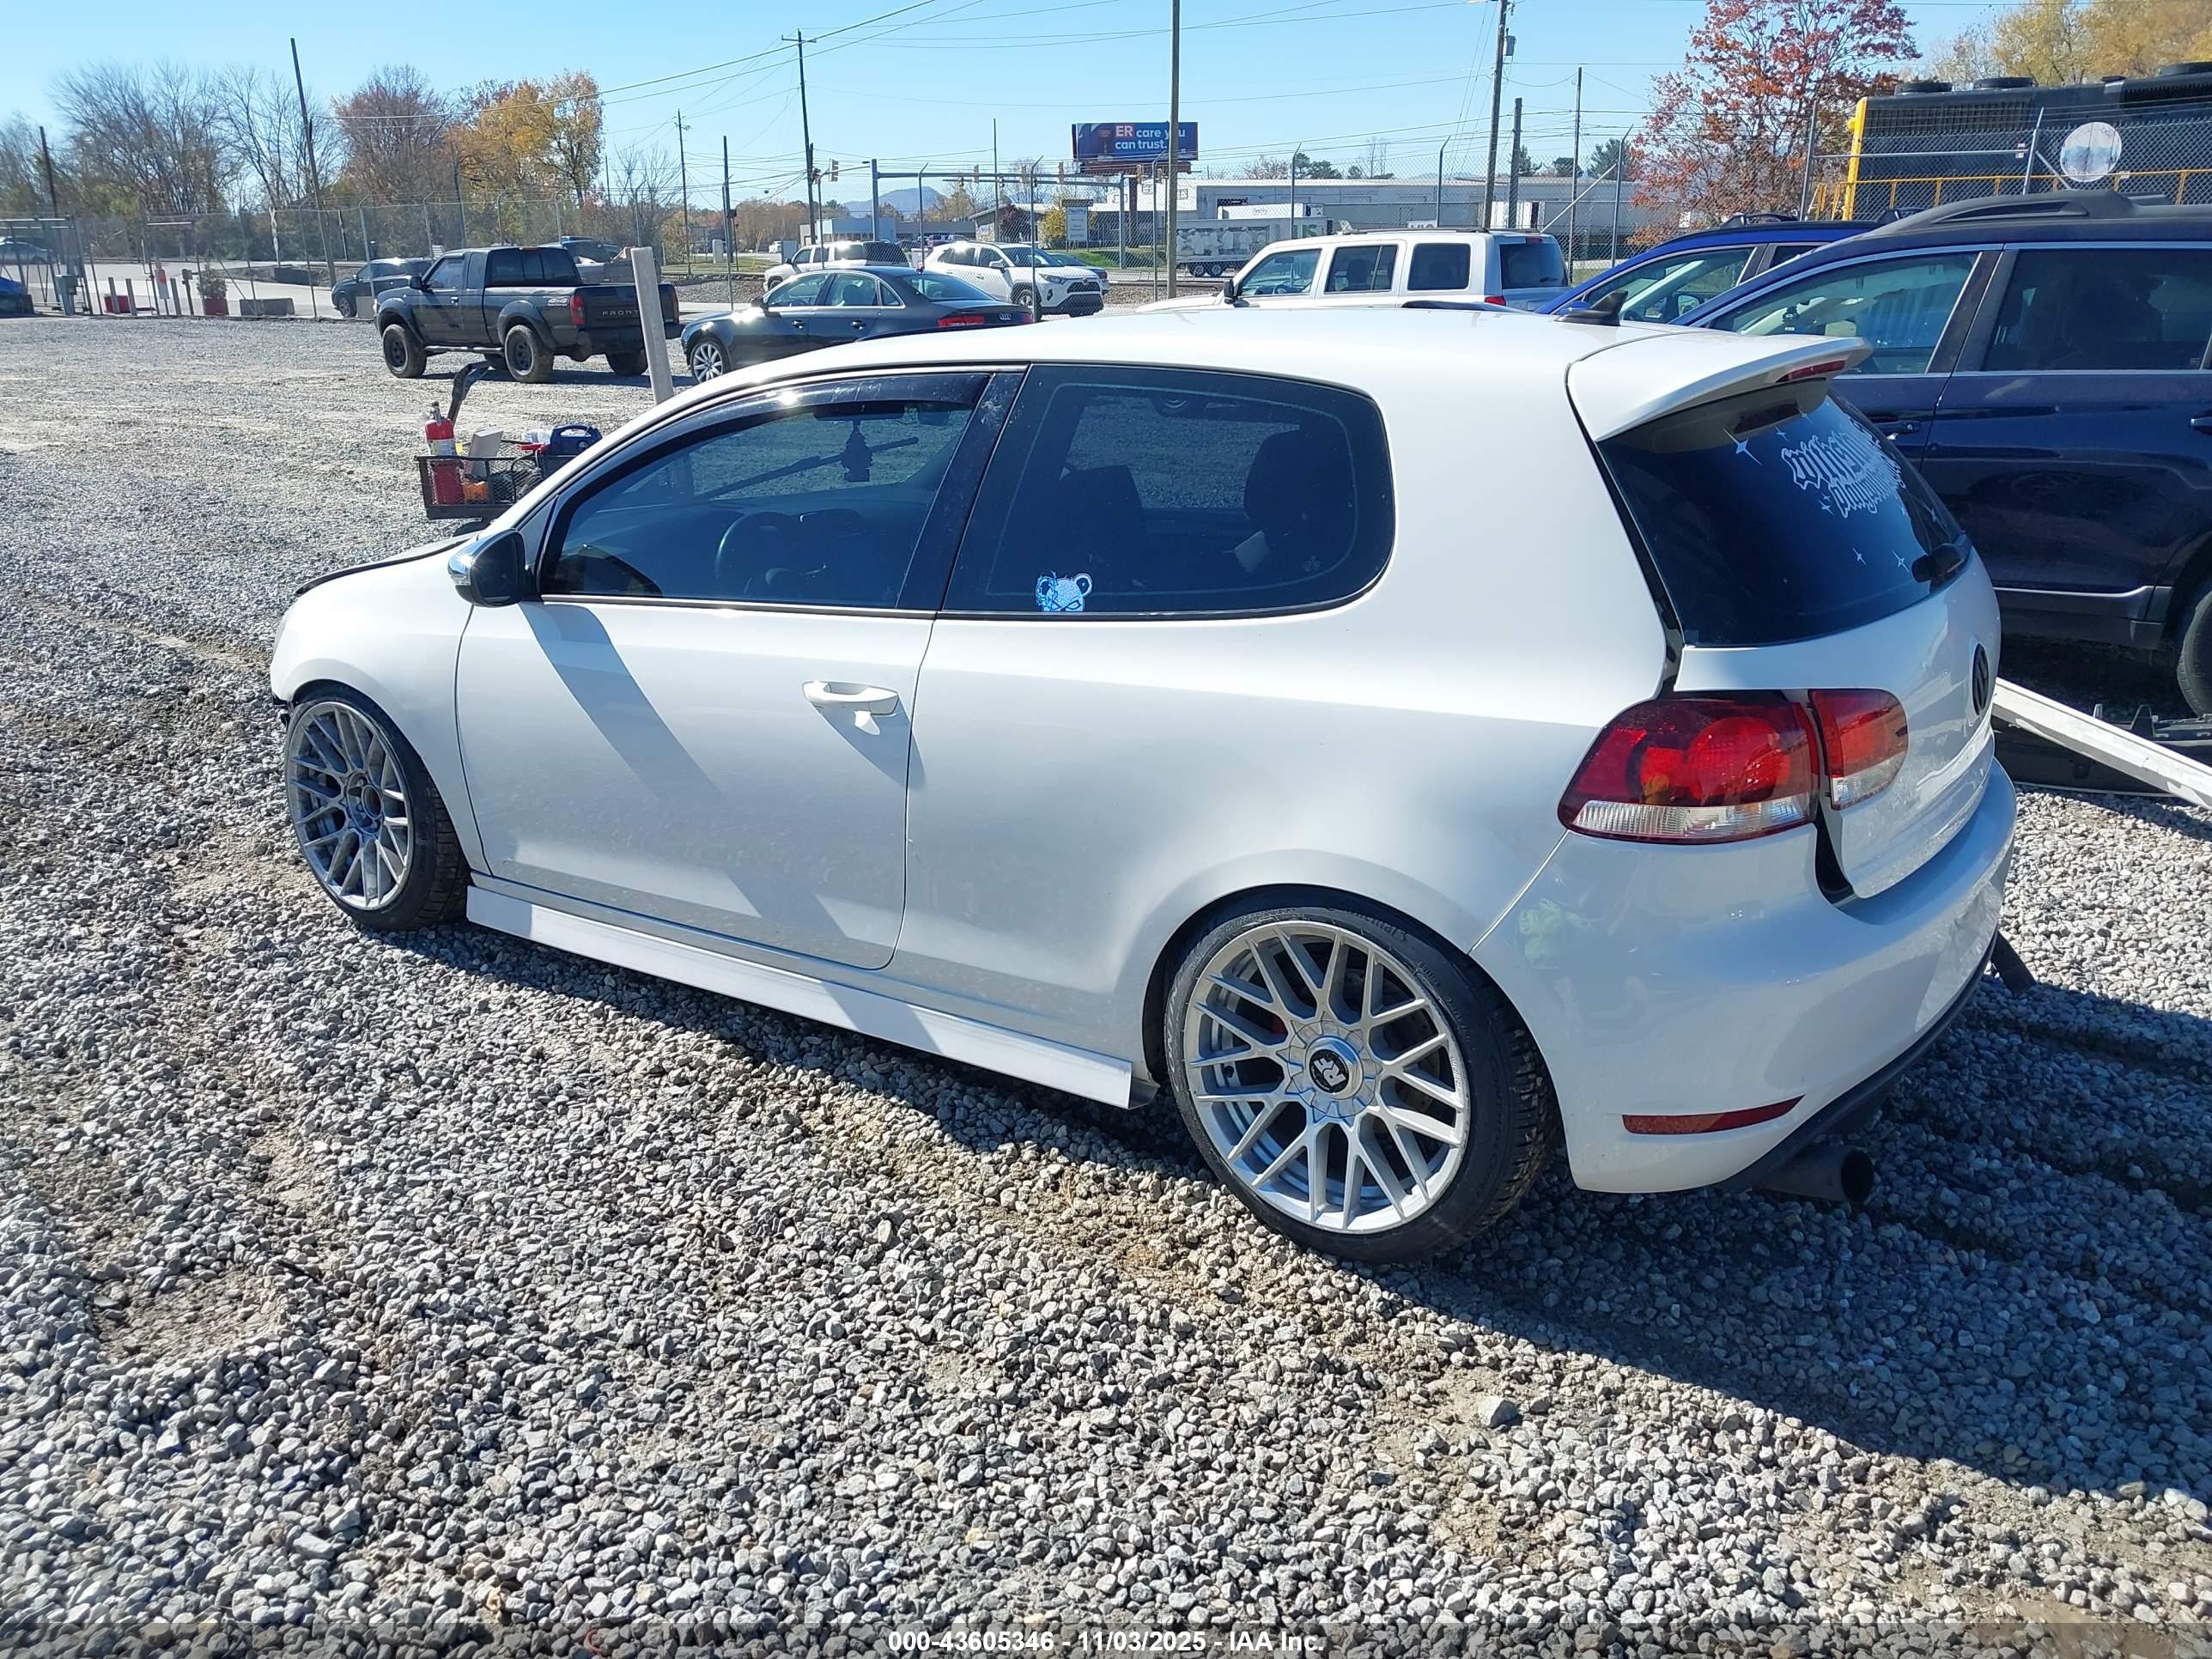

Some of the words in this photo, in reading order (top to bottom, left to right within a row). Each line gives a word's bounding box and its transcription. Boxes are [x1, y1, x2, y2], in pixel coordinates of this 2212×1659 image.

[1115, 125, 1133, 137] ER
[1164, 130, 1186, 139] yu
[1138, 139, 1168, 149] trust.
